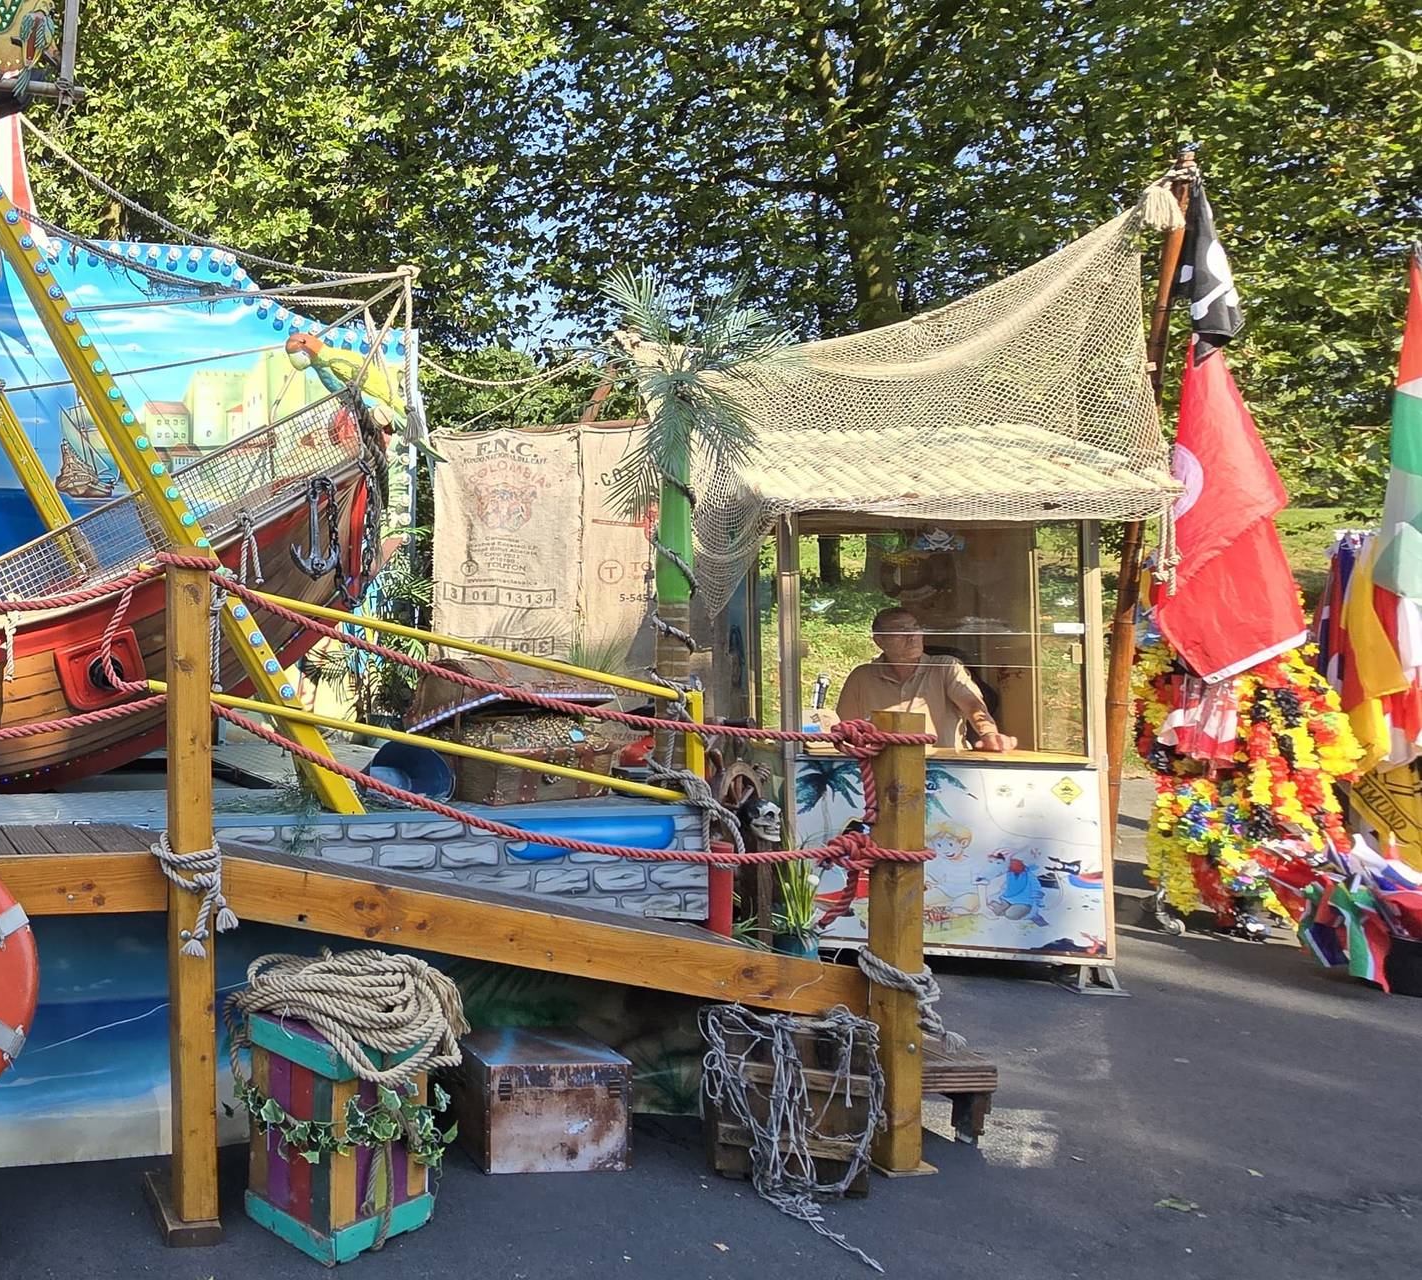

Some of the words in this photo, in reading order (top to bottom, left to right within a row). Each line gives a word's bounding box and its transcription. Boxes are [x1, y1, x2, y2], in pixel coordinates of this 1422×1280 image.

[476, 438, 538, 458] F.N.C.
[487, 562, 526, 572] TOUTON
[450, 587, 458, 600] 3
[472, 591, 488, 601] 01
